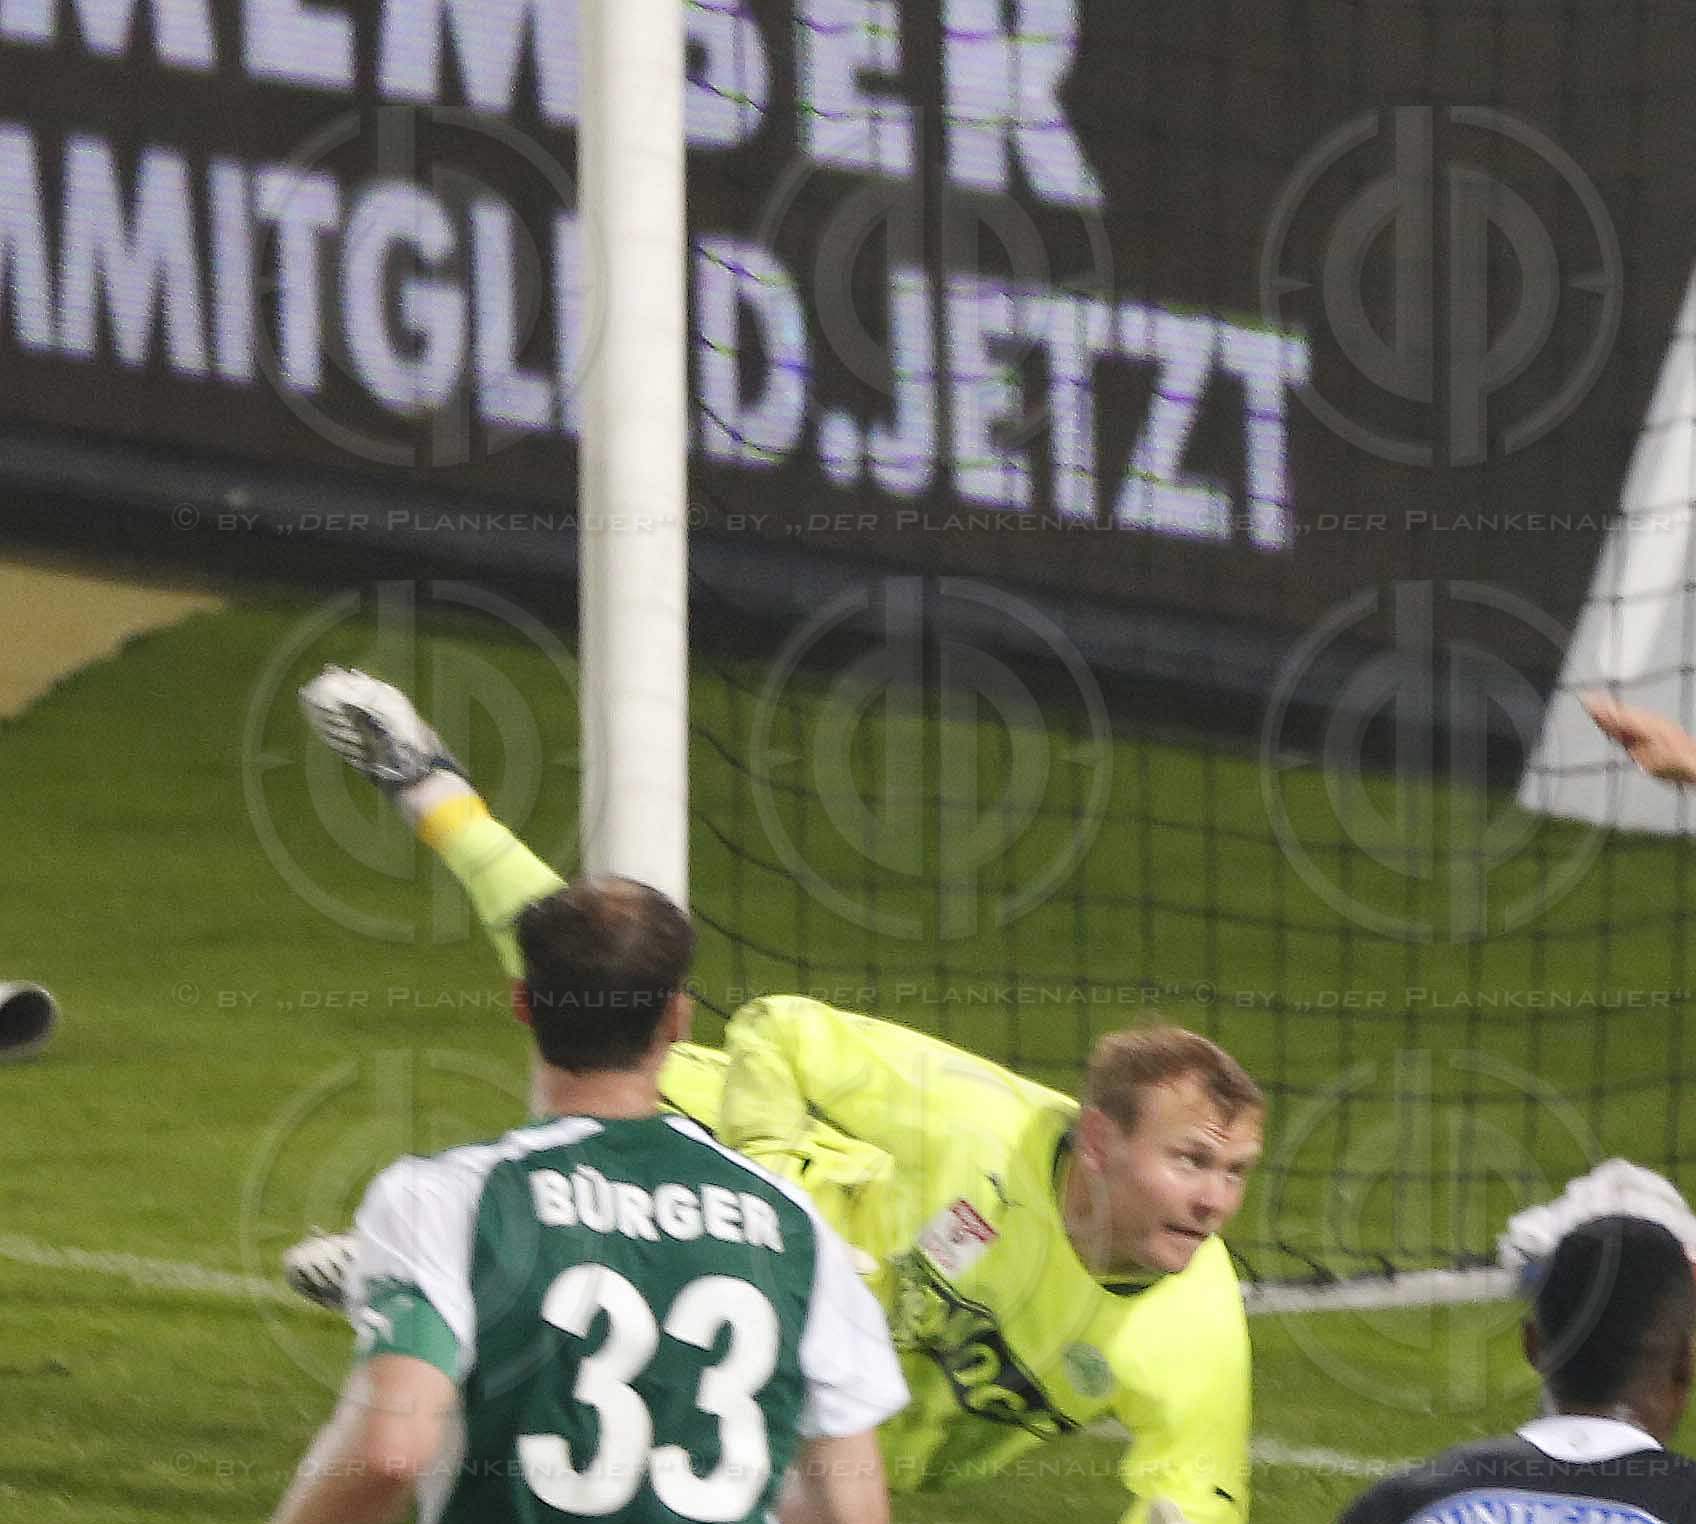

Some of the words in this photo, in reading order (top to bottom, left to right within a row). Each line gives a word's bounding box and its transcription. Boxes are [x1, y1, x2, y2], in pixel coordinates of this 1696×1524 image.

[0, 0, 1103, 208] MER
[0, 120, 1311, 551] MITGLID.JETZT
[529, 1163, 784, 1253] BÜRGER
[516, 1261, 781, 1523] 33
